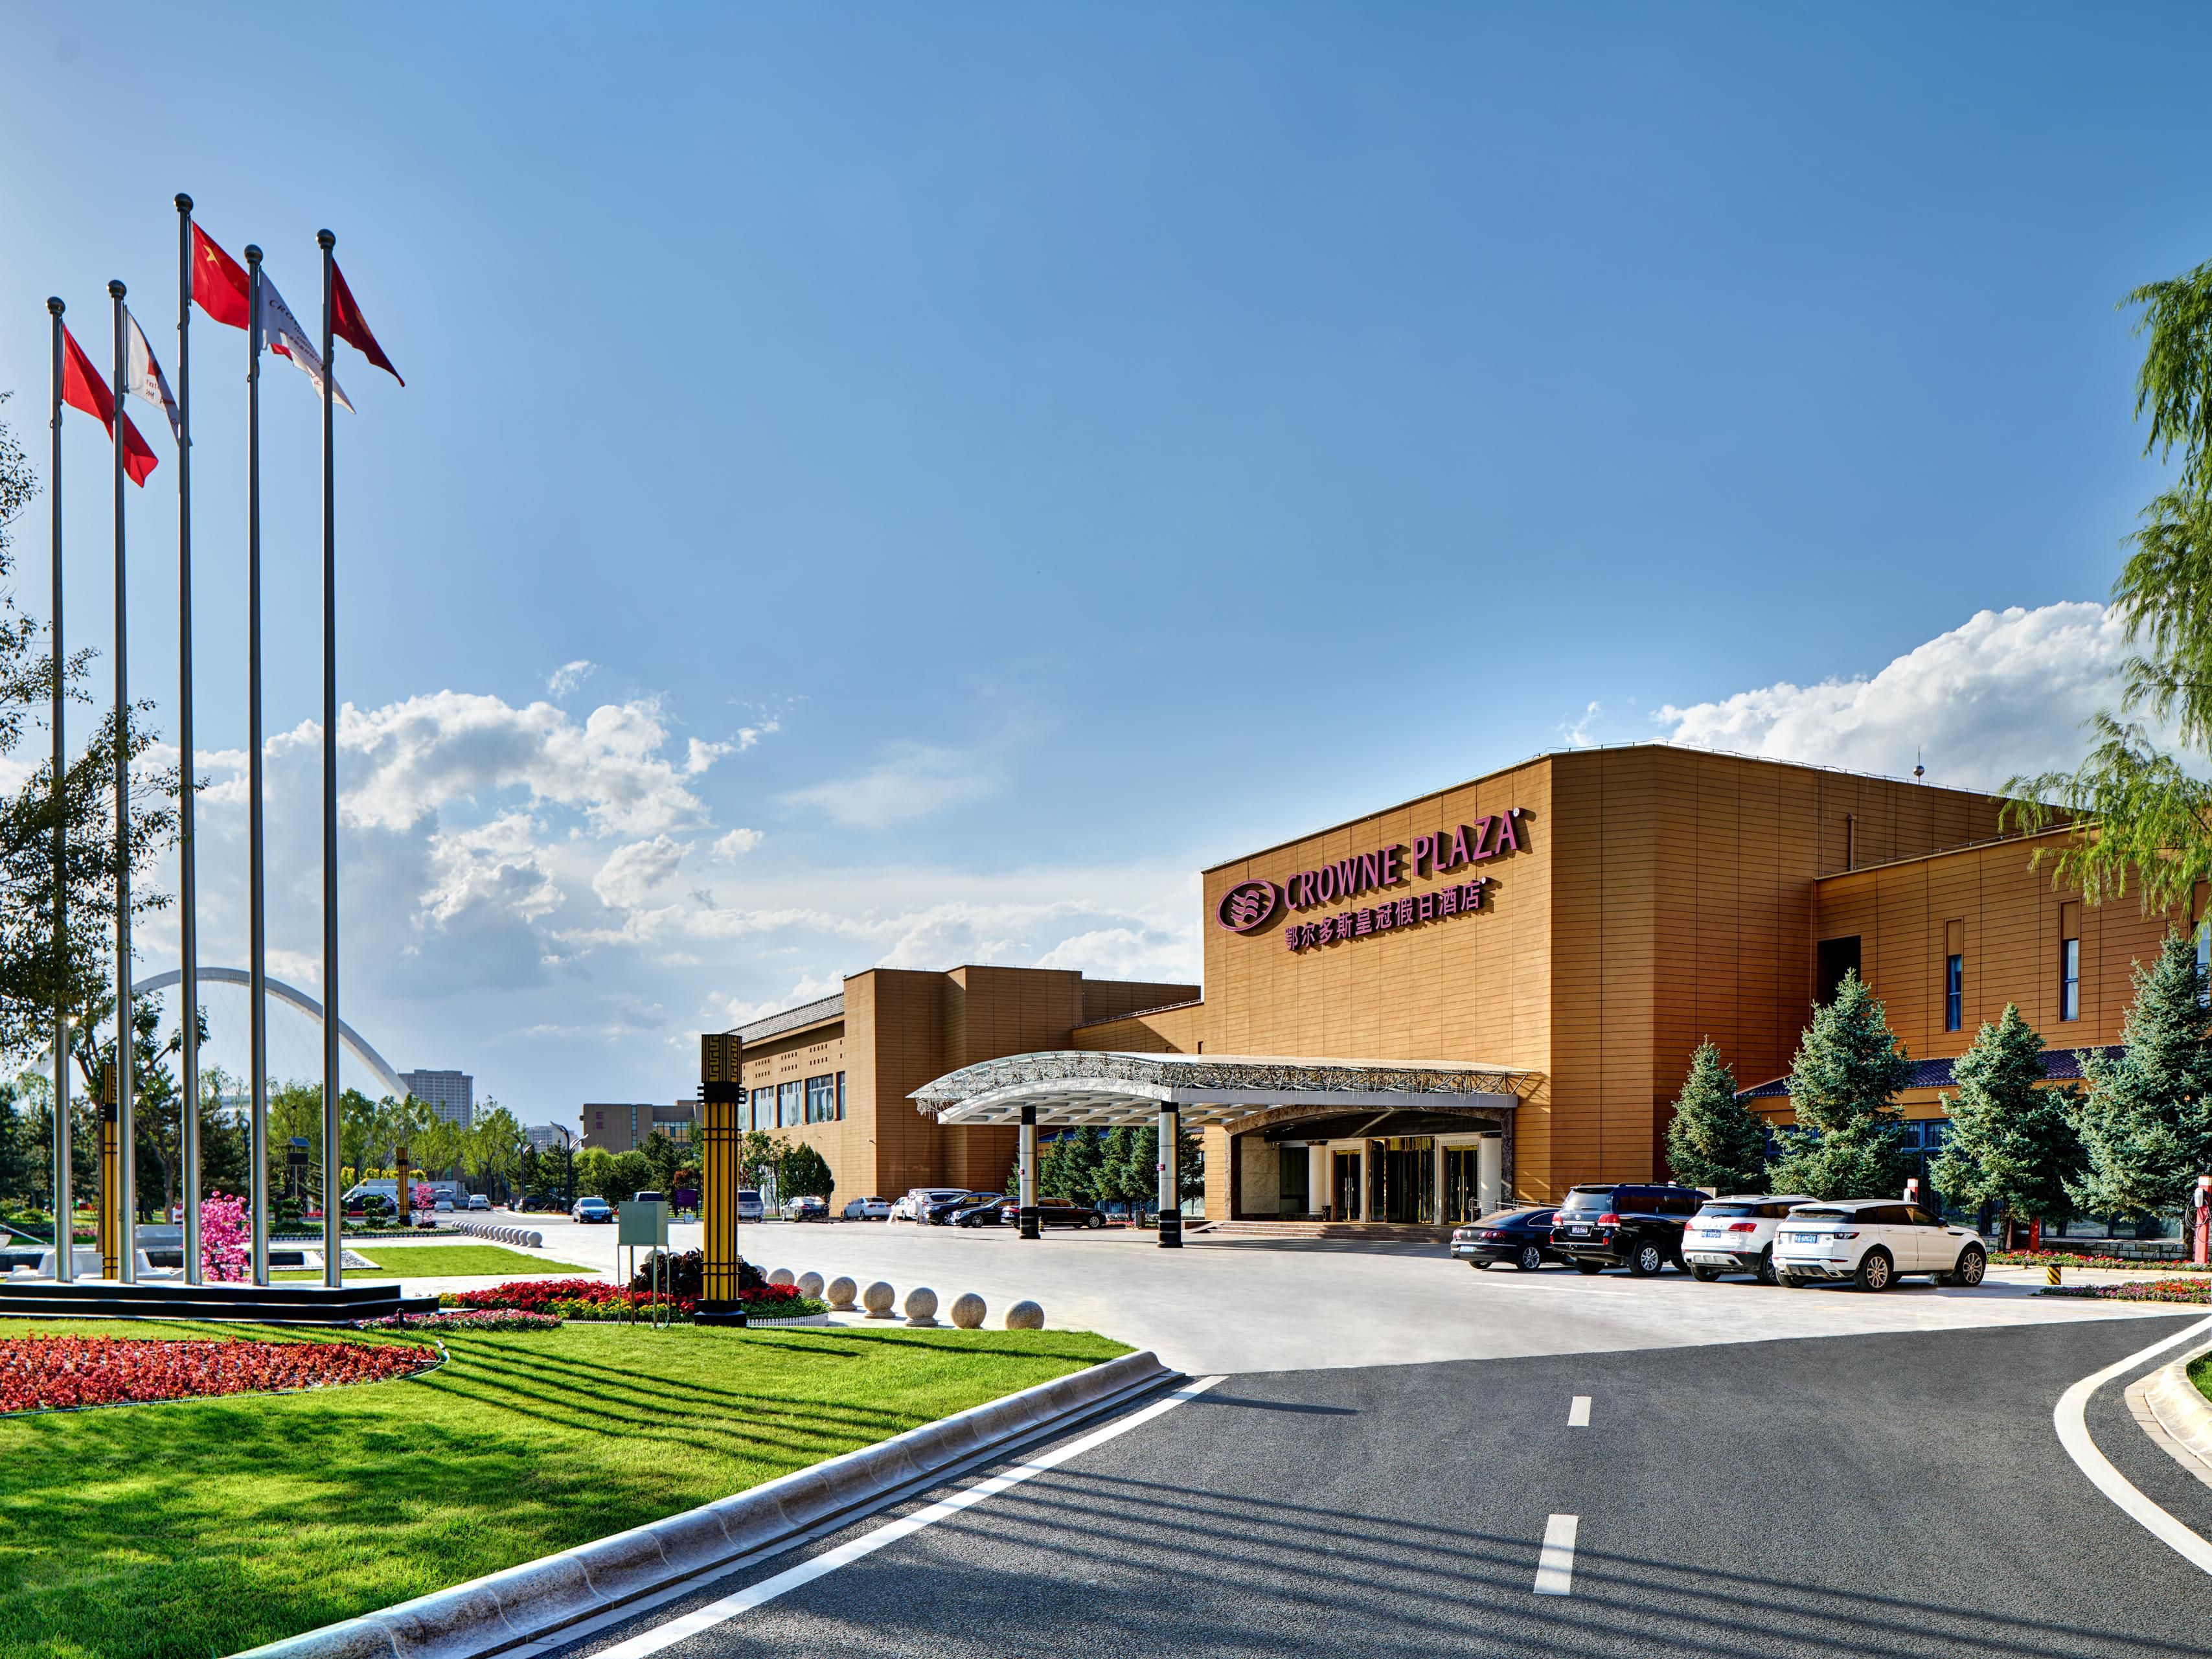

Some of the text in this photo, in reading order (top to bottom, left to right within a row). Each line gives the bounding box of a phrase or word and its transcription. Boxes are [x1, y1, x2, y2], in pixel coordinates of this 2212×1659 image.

[1284, 810, 1519, 910] CROWNE PLAZA
[1284, 879, 1482, 951] 鄂尔多斯皇冠假日酒店
